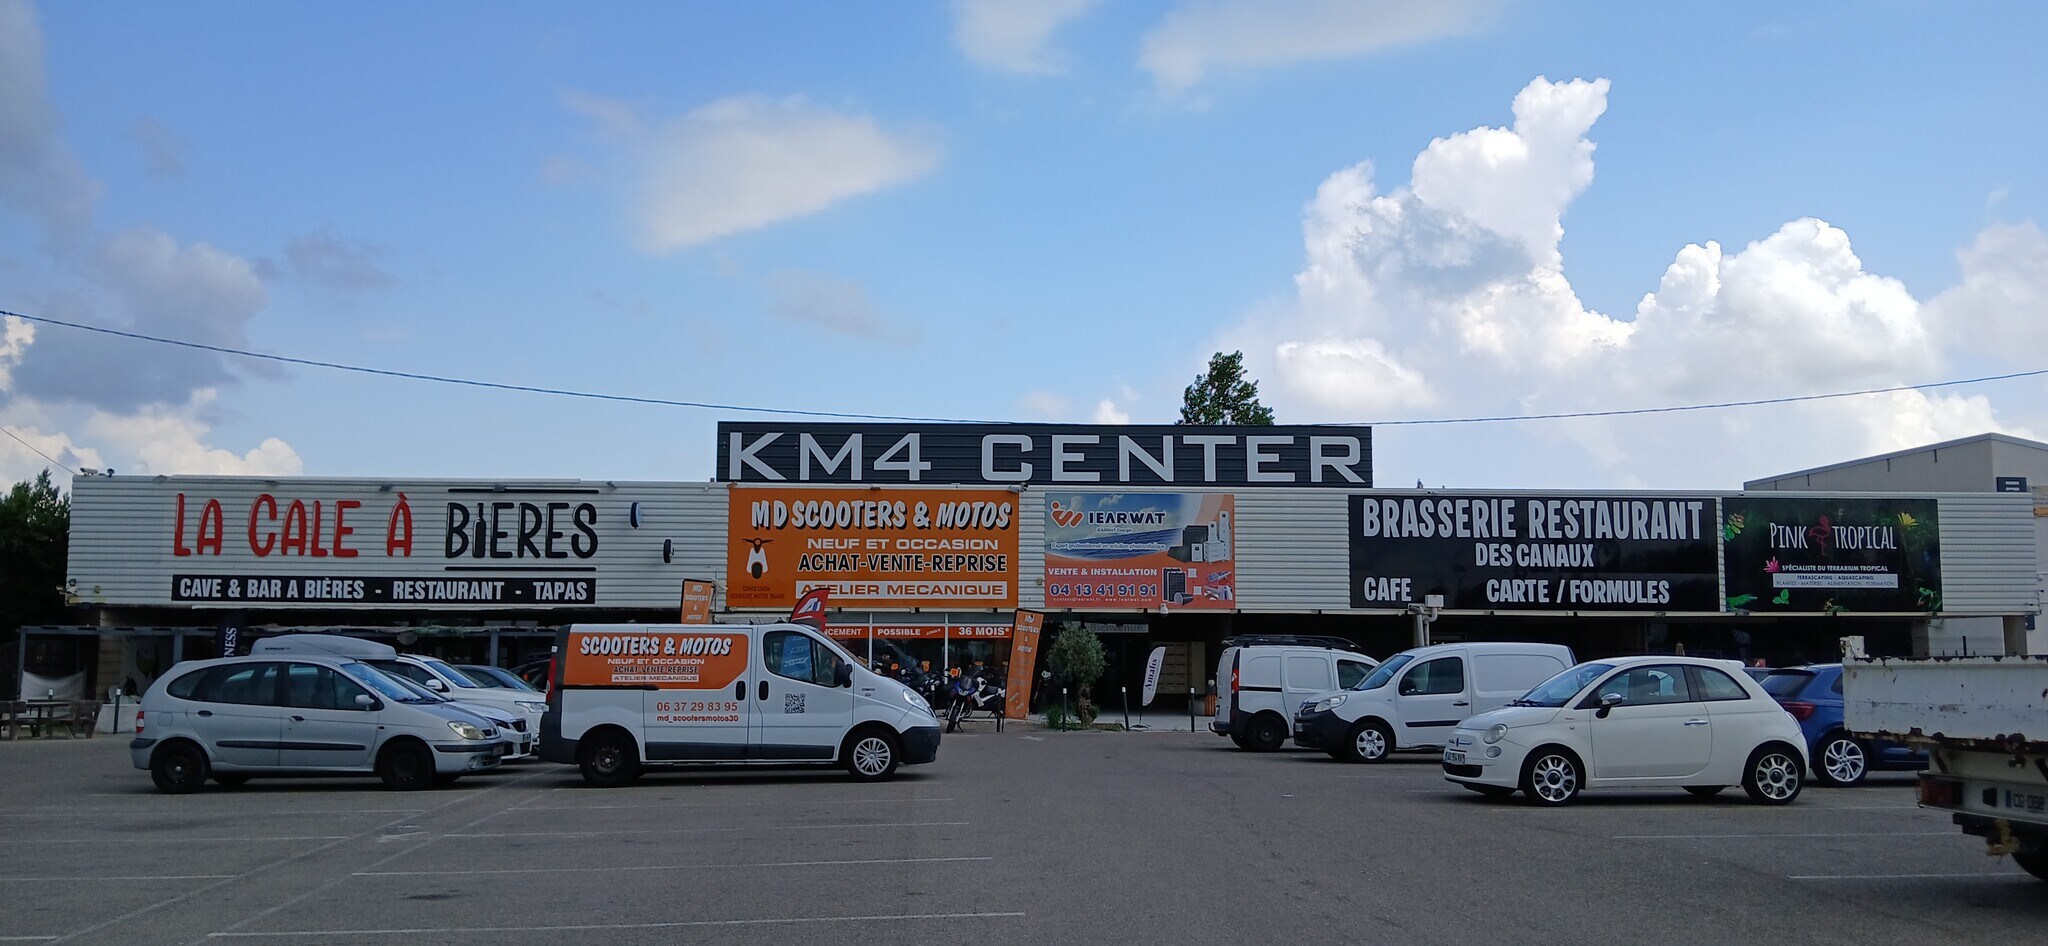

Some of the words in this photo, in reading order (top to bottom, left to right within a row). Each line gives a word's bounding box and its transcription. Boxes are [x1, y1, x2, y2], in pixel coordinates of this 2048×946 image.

[728, 432, 932, 481] KM4
[981, 433, 1366, 483] CENTER
[791, 500, 907, 530] SCOOTERS
[912, 501, 930, 530] &
[935, 502, 1013, 530] MOTOS
[1089, 512, 1166, 524] IEARWAT
[1363, 498, 1516, 538] BRASSERIE
[1528, 499, 1703, 540] RESTAURANT
[173, 493, 224, 557] LA
[248, 494, 362, 557] CALE
[387, 491, 413, 557] À
[1769, 522, 1809, 549] PINK
[1831, 525, 1897, 550] TROPICAL
[807, 538, 860, 550] NEUF
[866, 538, 889, 550] ET
[896, 538, 999, 550] OCCASION
[1051, 542, 1068, 550] Expert
[1069, 542, 1101, 550] professionnel
[1475, 542, 1513, 567] DES
[1516, 543, 1594, 568] CANAUX
[1048, 567, 1078, 576] VENTE
[1081, 568, 1089, 576] &
[1091, 568, 1158, 576] INSTALLATION
[1781, 564, 1816, 572] SPÉCIALISTE
[180, 578, 221, 598] CAVE
[228, 578, 241, 598] &
[247, 578, 281, 598] BAR
[286, 579, 298, 598] A
[305, 577, 364, 599] BIÈRES
[393, 580, 505, 600] RESTAURANT
[533, 581, 588, 600] TAPAS
[801, 584, 880, 596] ATELIER
[887, 584, 1004, 596] MECANIQUE
[1050, 584, 1070, 596] 04
[1074, 584, 1093, 596] 13
[1096, 584, 1114, 596] 41
[1118, 584, 1135, 596] 91
[1138, 584, 1157, 596] 91
[1364, 577, 1412, 602] CAFE
[1486, 578, 1550, 604] CARTE
[1556, 578, 1567, 604] /
[1570, 579, 1671, 604] FORMULES
[877, 628, 921, 636] POSSIBLE
[958, 627, 972, 636] 36
[1017, 624, 1039, 634] SCOOTERS
[1090, 624, 1146, 632] Bienvenue
[223, 627, 237, 658] NESS
[580, 635, 661, 656] SCOOTERS
[664, 636, 677, 656] &
[679, 637, 733, 657] MOTOS
[1144, 658, 1158, 691] Amalis
[657, 702, 670, 711] 06
[673, 702, 687, 711] 37
[690, 702, 704, 711] 29
[707, 702, 721, 711] 83
[724, 702, 738, 711] 95
[657, 714, 739, 723] md_scootersmotos30
